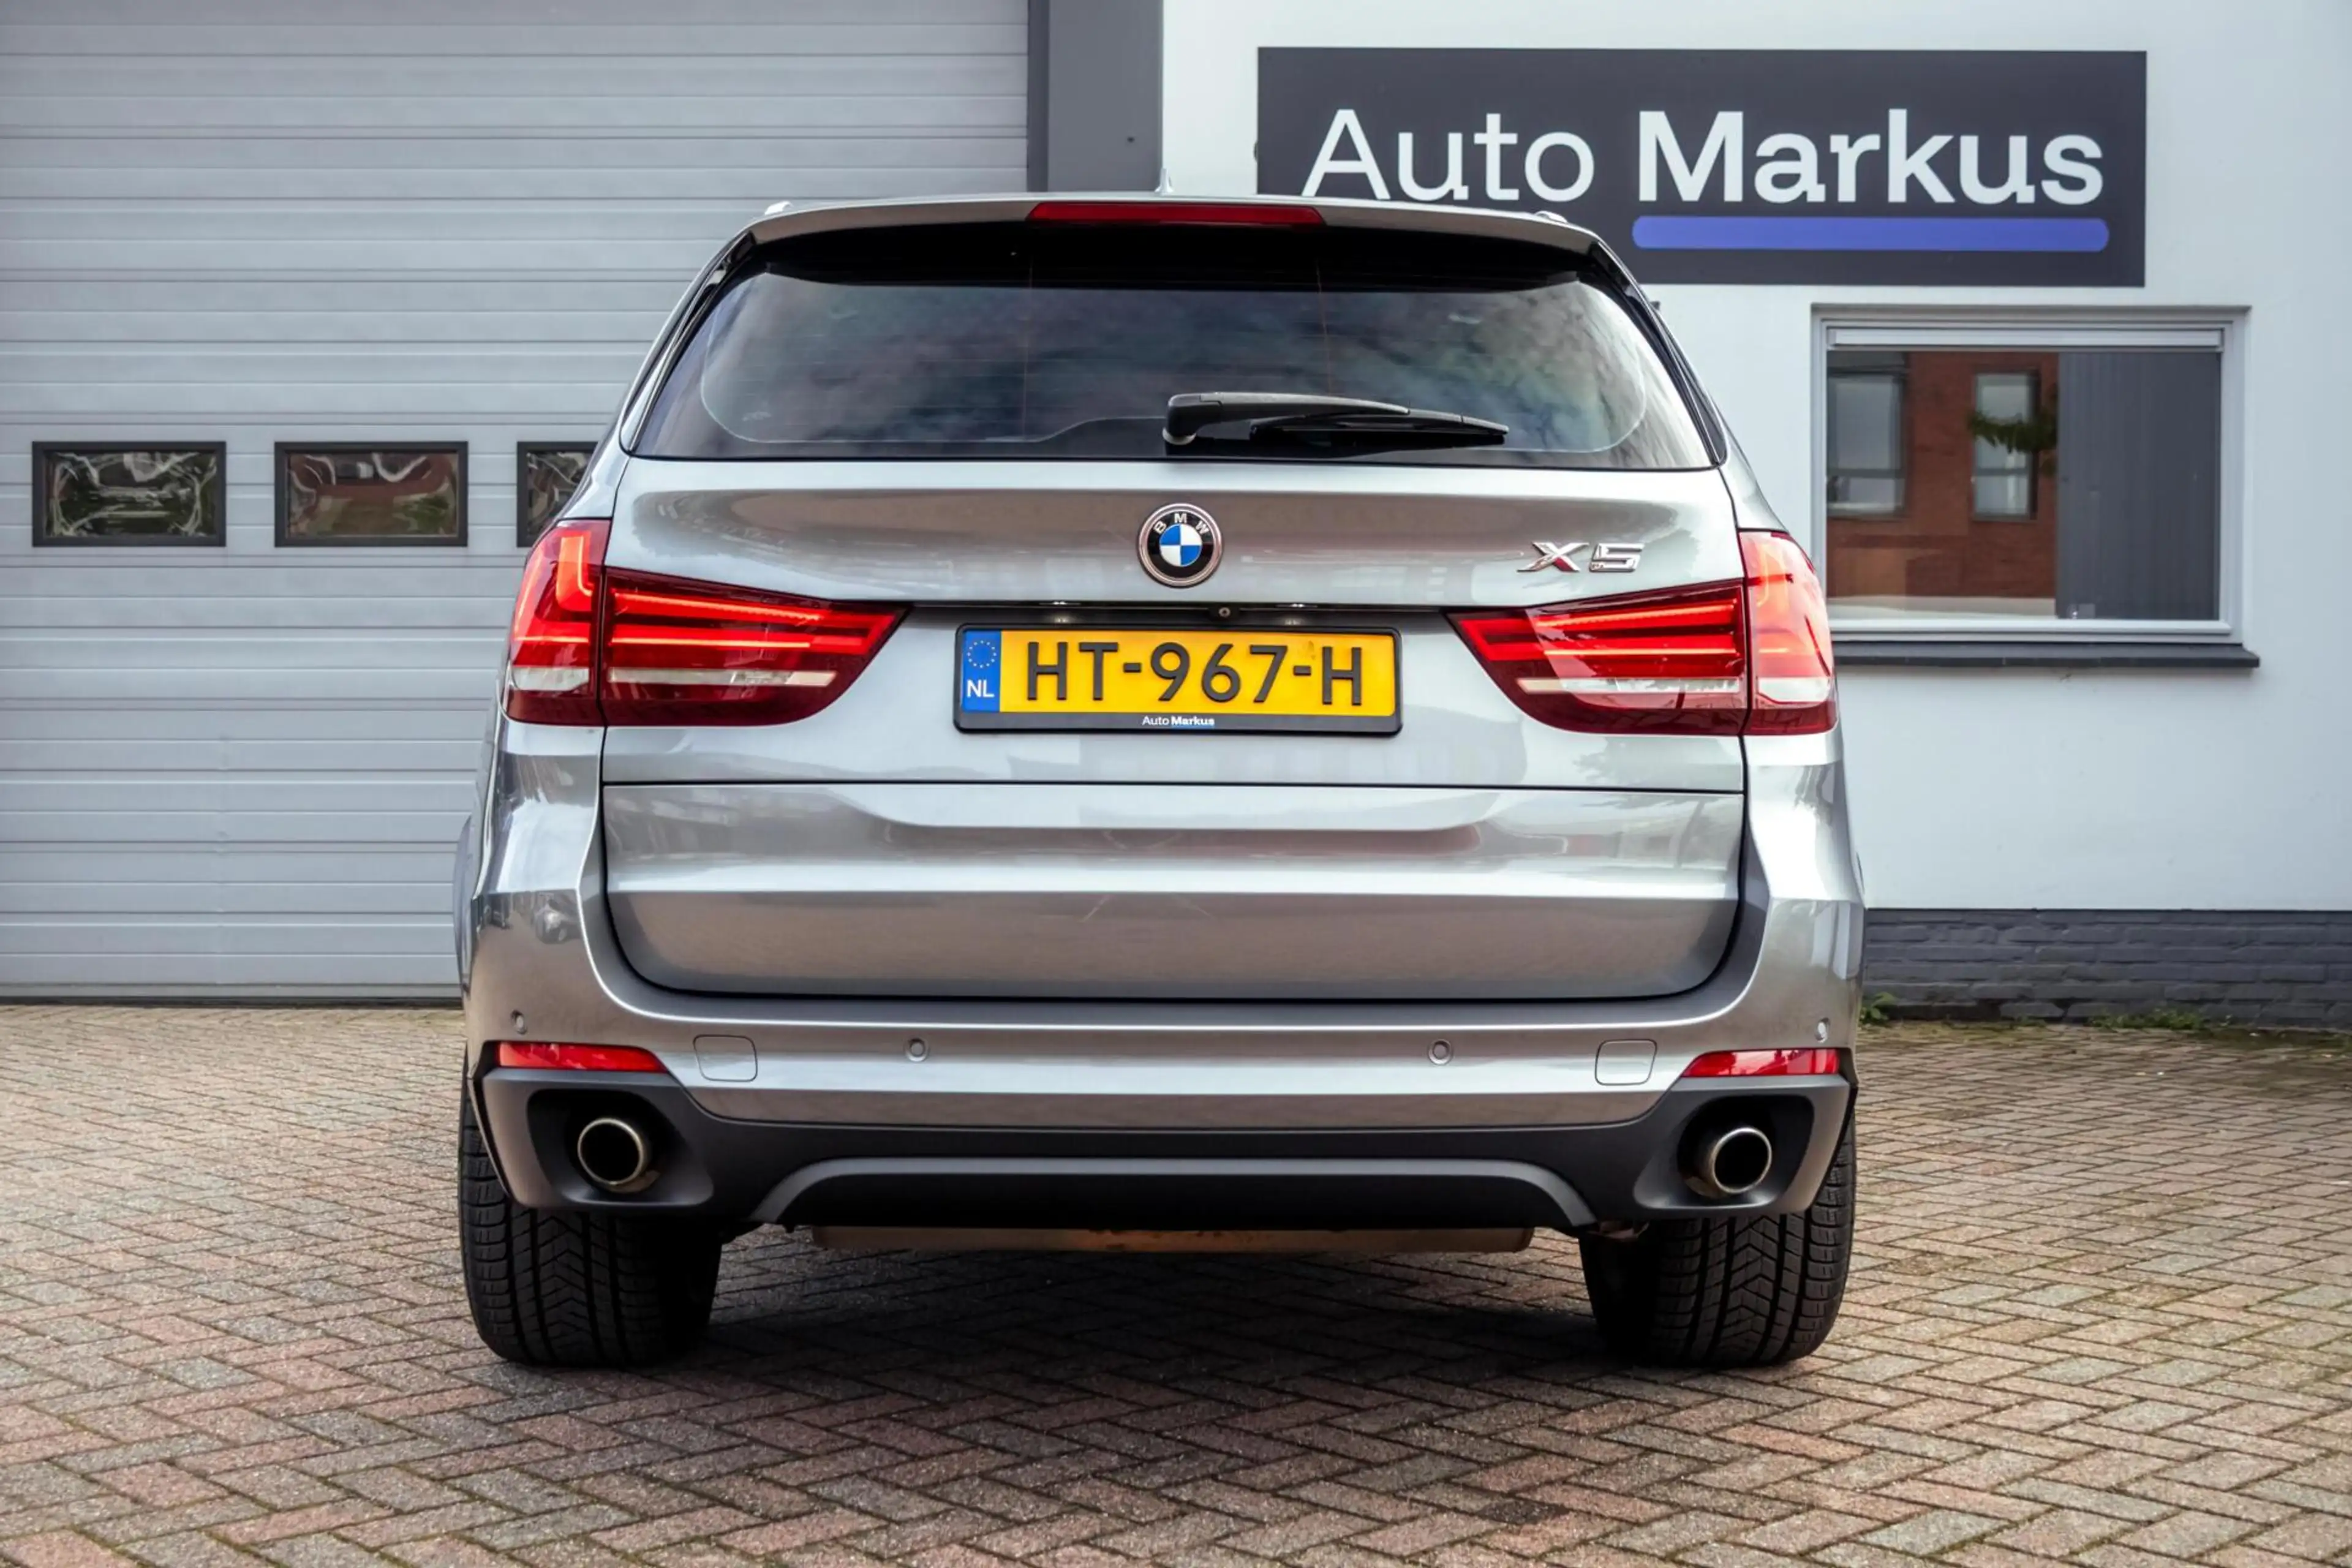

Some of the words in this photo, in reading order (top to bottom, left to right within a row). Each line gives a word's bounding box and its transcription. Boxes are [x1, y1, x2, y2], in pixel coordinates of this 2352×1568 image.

[1303, 109, 1595, 202] Auto
[1638, 108, 2103, 205] Markus
[1154, 513, 1210, 535] BMW
[1517, 541, 1645, 573] X5
[1027, 641, 1363, 706] HT-967-H
[967, 679, 995, 698] NL
[1142, 715, 1170, 726] Auto
[1170, 715, 1215, 727] Markus
